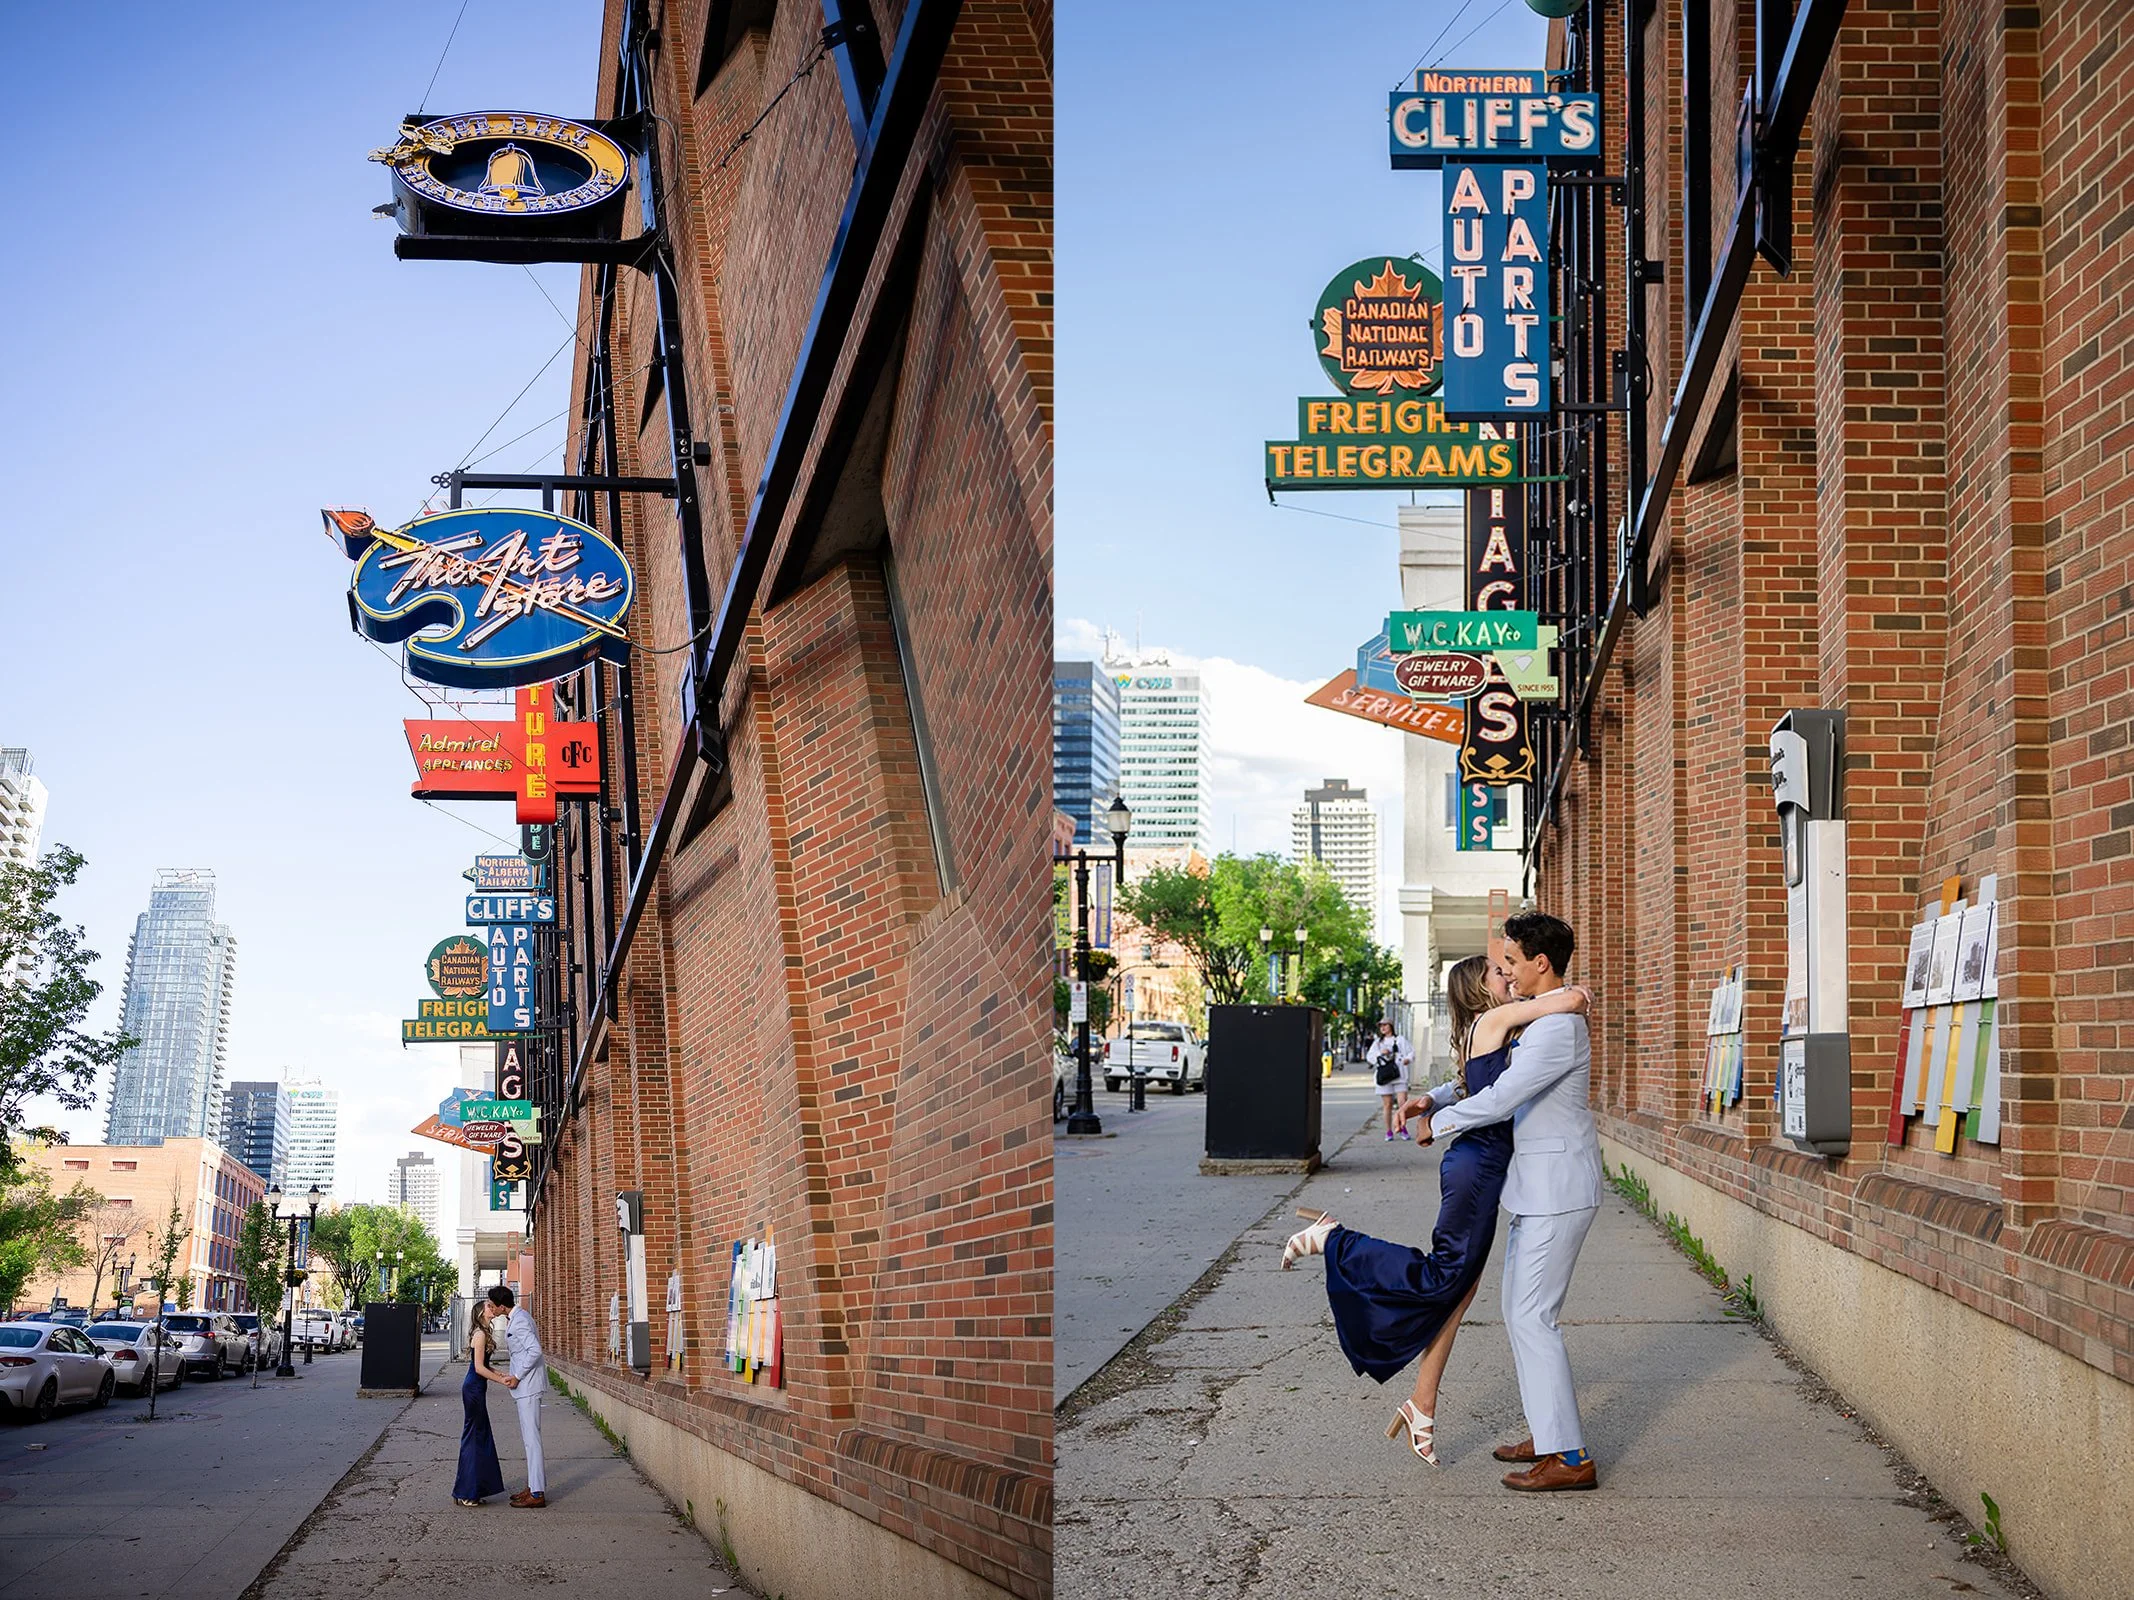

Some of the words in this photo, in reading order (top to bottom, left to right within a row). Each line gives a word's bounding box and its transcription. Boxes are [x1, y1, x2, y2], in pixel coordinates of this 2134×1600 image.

[1423, 73, 1533, 93] NORTHERN
[1392, 95, 1596, 150] CLIFF'S
[400, 163, 508, 211] HEALTH
[522, 167, 617, 212] BAKERY
[1448, 167, 1491, 358] AUTO
[1500, 169, 1543, 407] PARTS
[1346, 299, 1428, 320] CANADIAN
[1347, 323, 1428, 344] NATIONAL
[1346, 346, 1429, 368] RAILWAYS
[1269, 444, 1513, 478] TELEGRAMS
[468, 527, 584, 618] Art
[457, 572, 623, 650] Store
[1405, 660, 1470, 672] JEWELRY
[1135, 676, 1173, 690] CWB
[1408, 674, 1478, 688] GIFTWARE
[1517, 684, 1539, 692] SINCE
[1540, 684, 1555, 692] 1955
[1332, 688, 1449, 731] SERVICE
[418, 732, 501, 753] Admiral
[422, 758, 513, 773] APPLIANCES
[478, 876, 528, 887] RAILWAYS
[488, 867, 530, 877] ALBERTA
[467, 898, 553, 920] CLIFF'S
[441, 954, 480, 964] CANADIAN
[443, 965, 480, 975] NATIONAL
[490, 927, 509, 1007] AUTO
[513, 927, 531, 1028] PARTS
[441, 976, 481, 986] RAILWAYS
[422, 1001, 489, 1017] FREIGH
[404, 1021, 518, 1038] TELEGRA
[468, 1131, 503, 1139] GIFTWARE
